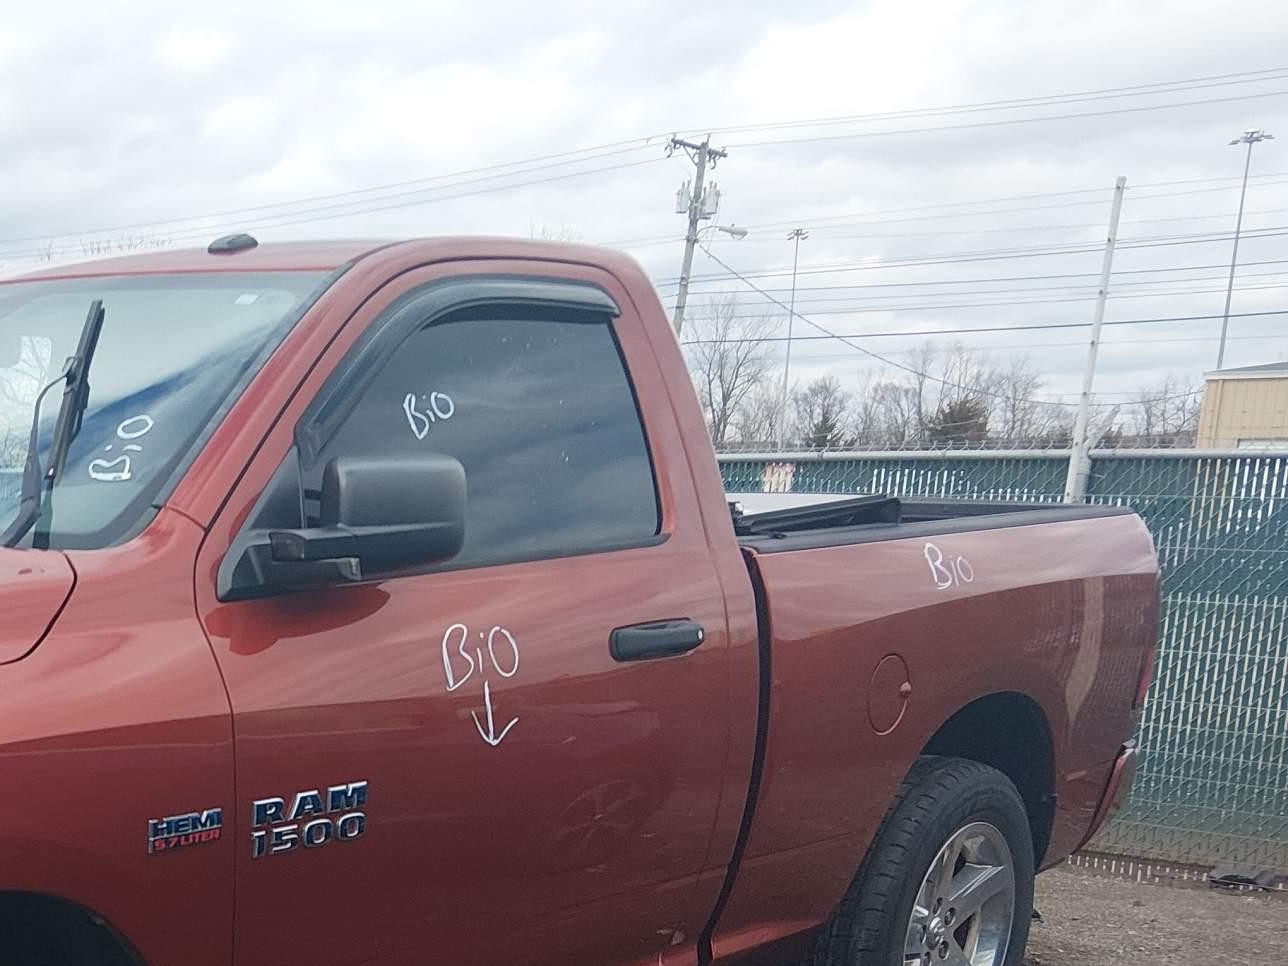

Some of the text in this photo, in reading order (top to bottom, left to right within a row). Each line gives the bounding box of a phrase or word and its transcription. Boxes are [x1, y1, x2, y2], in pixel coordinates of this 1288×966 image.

[147, 807, 223, 841] HEMI
[252, 780, 368, 828] RAM
[251, 812, 367, 859] 1500
